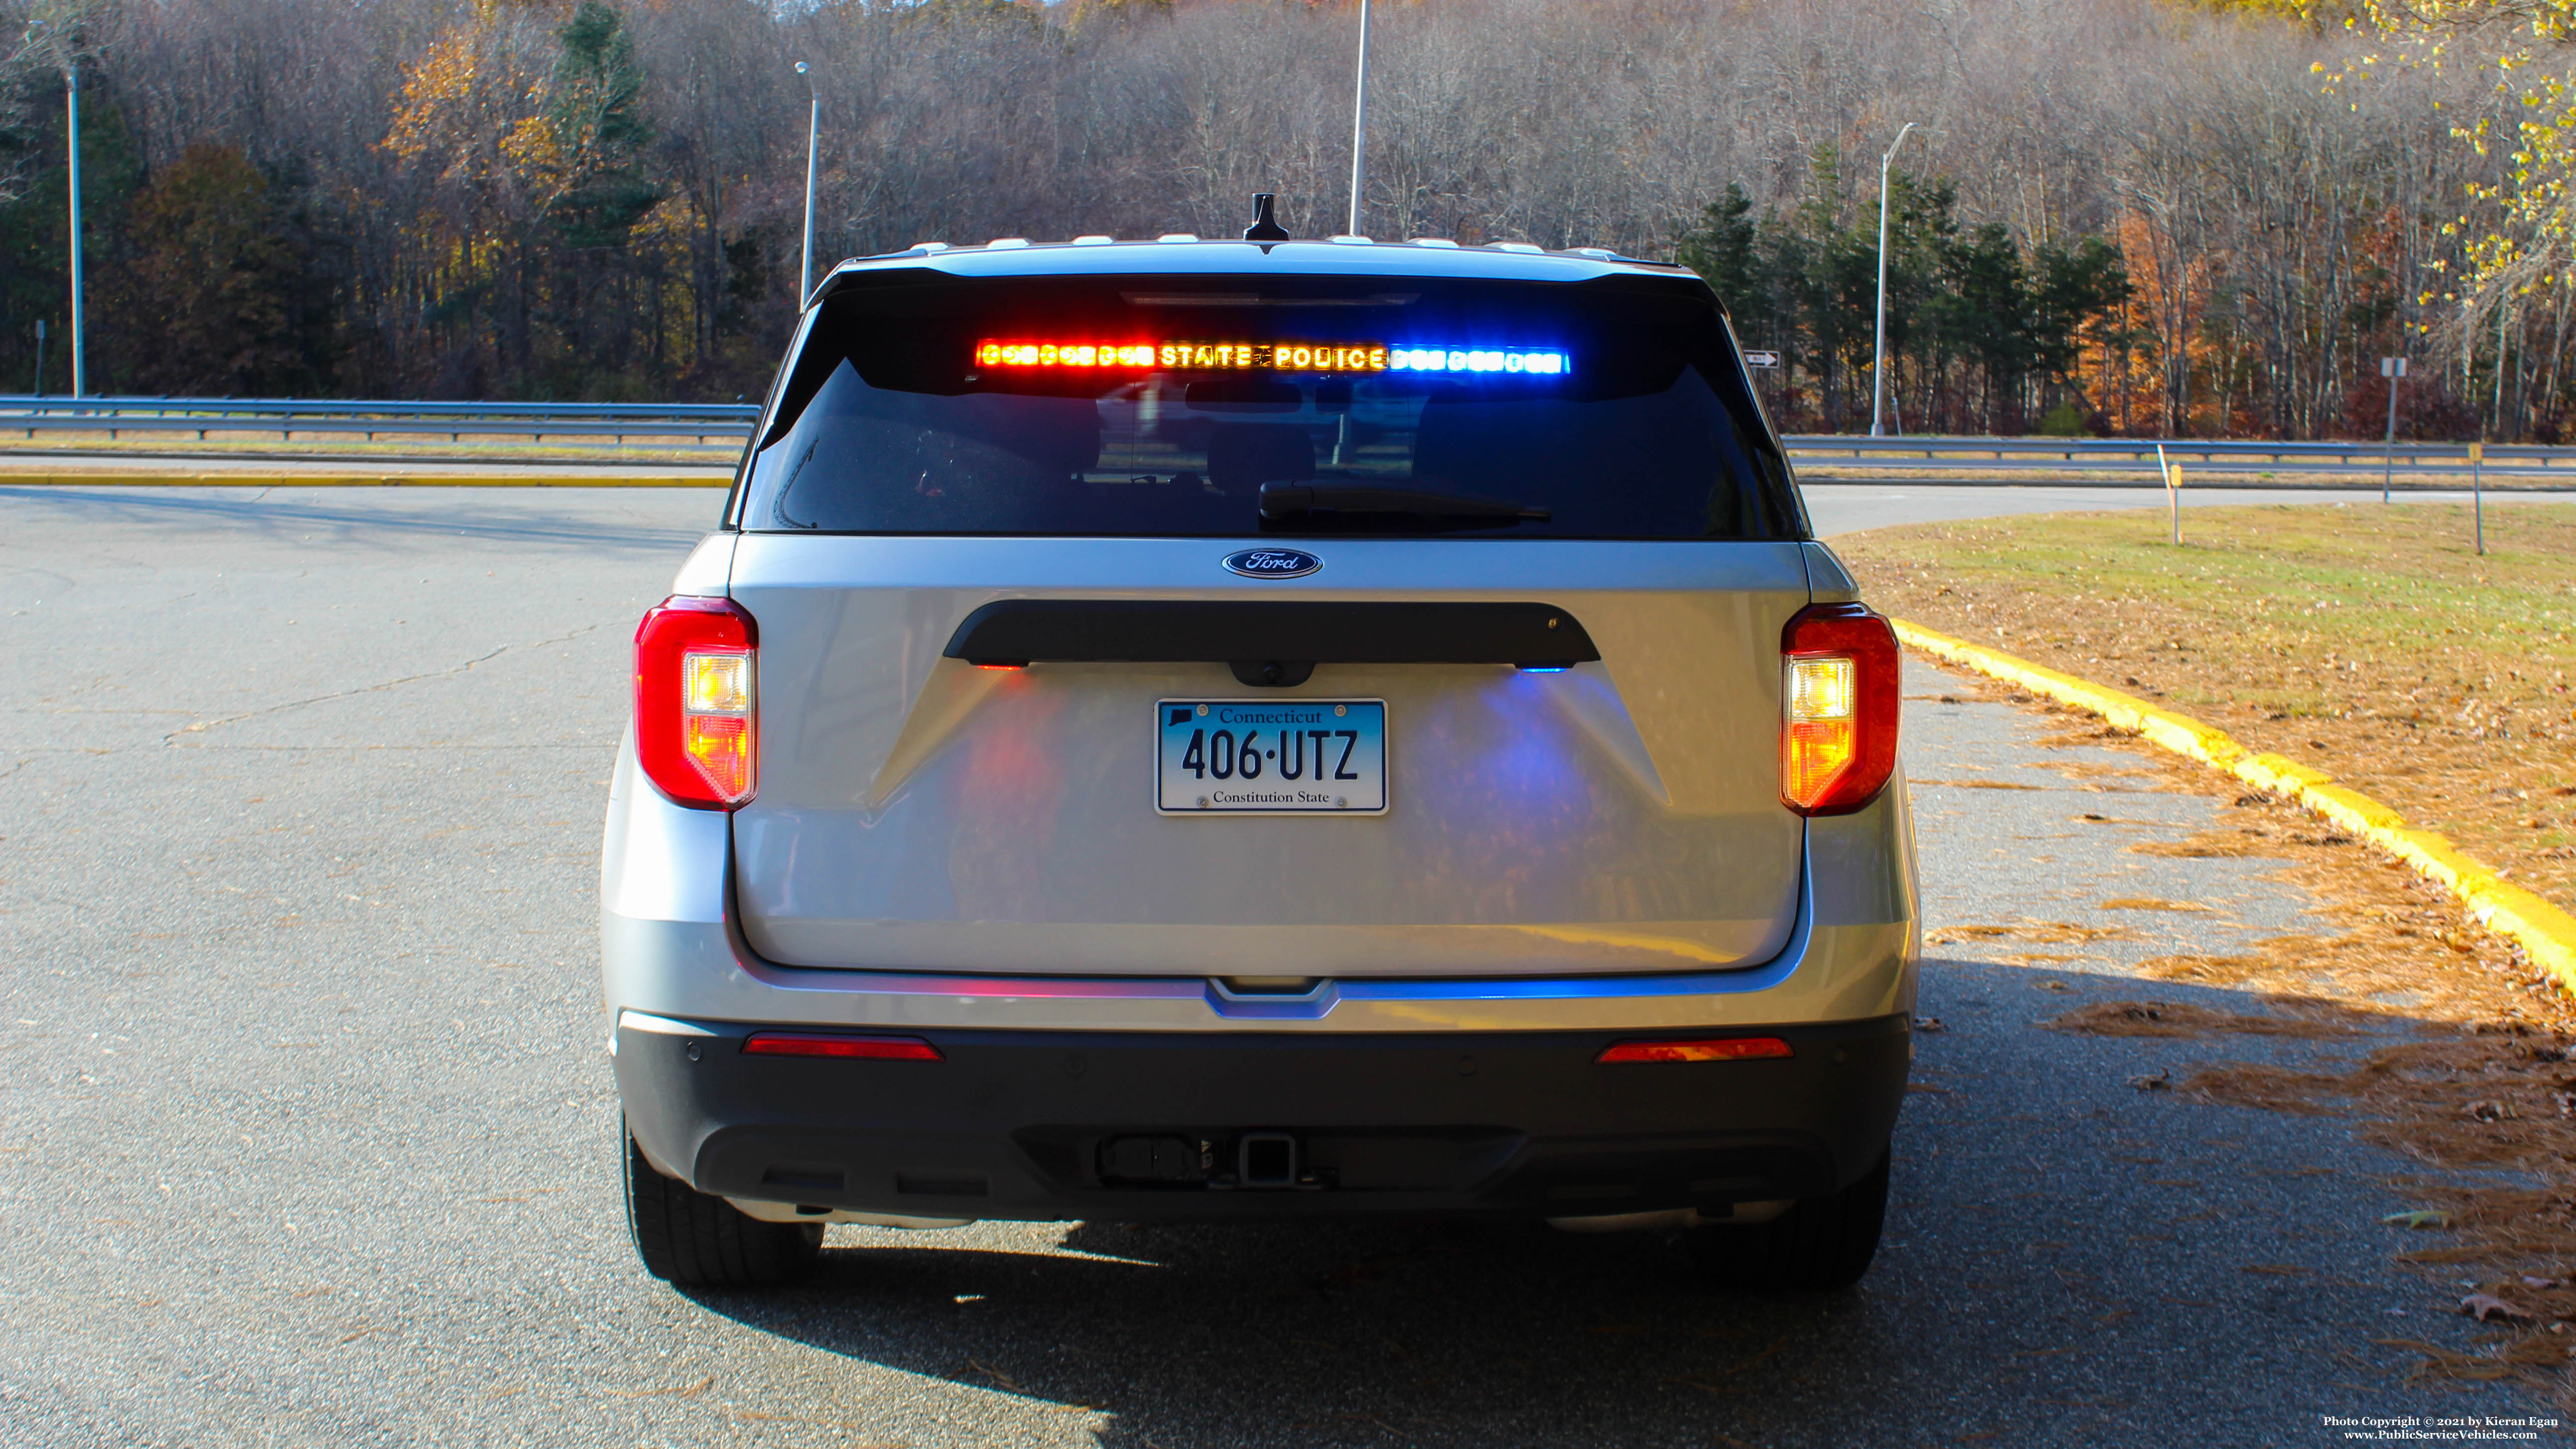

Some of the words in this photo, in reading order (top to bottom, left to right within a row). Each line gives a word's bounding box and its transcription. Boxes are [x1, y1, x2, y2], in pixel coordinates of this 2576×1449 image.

[1161, 346, 1251, 366] STATE
[1276, 347, 1383, 368] POLICE
[1246, 552, 1299, 569] Ford
[1220, 708, 1321, 724] Connecticut
[1213, 791, 1293, 803] Constitution
[1297, 791, 1329, 803] State
